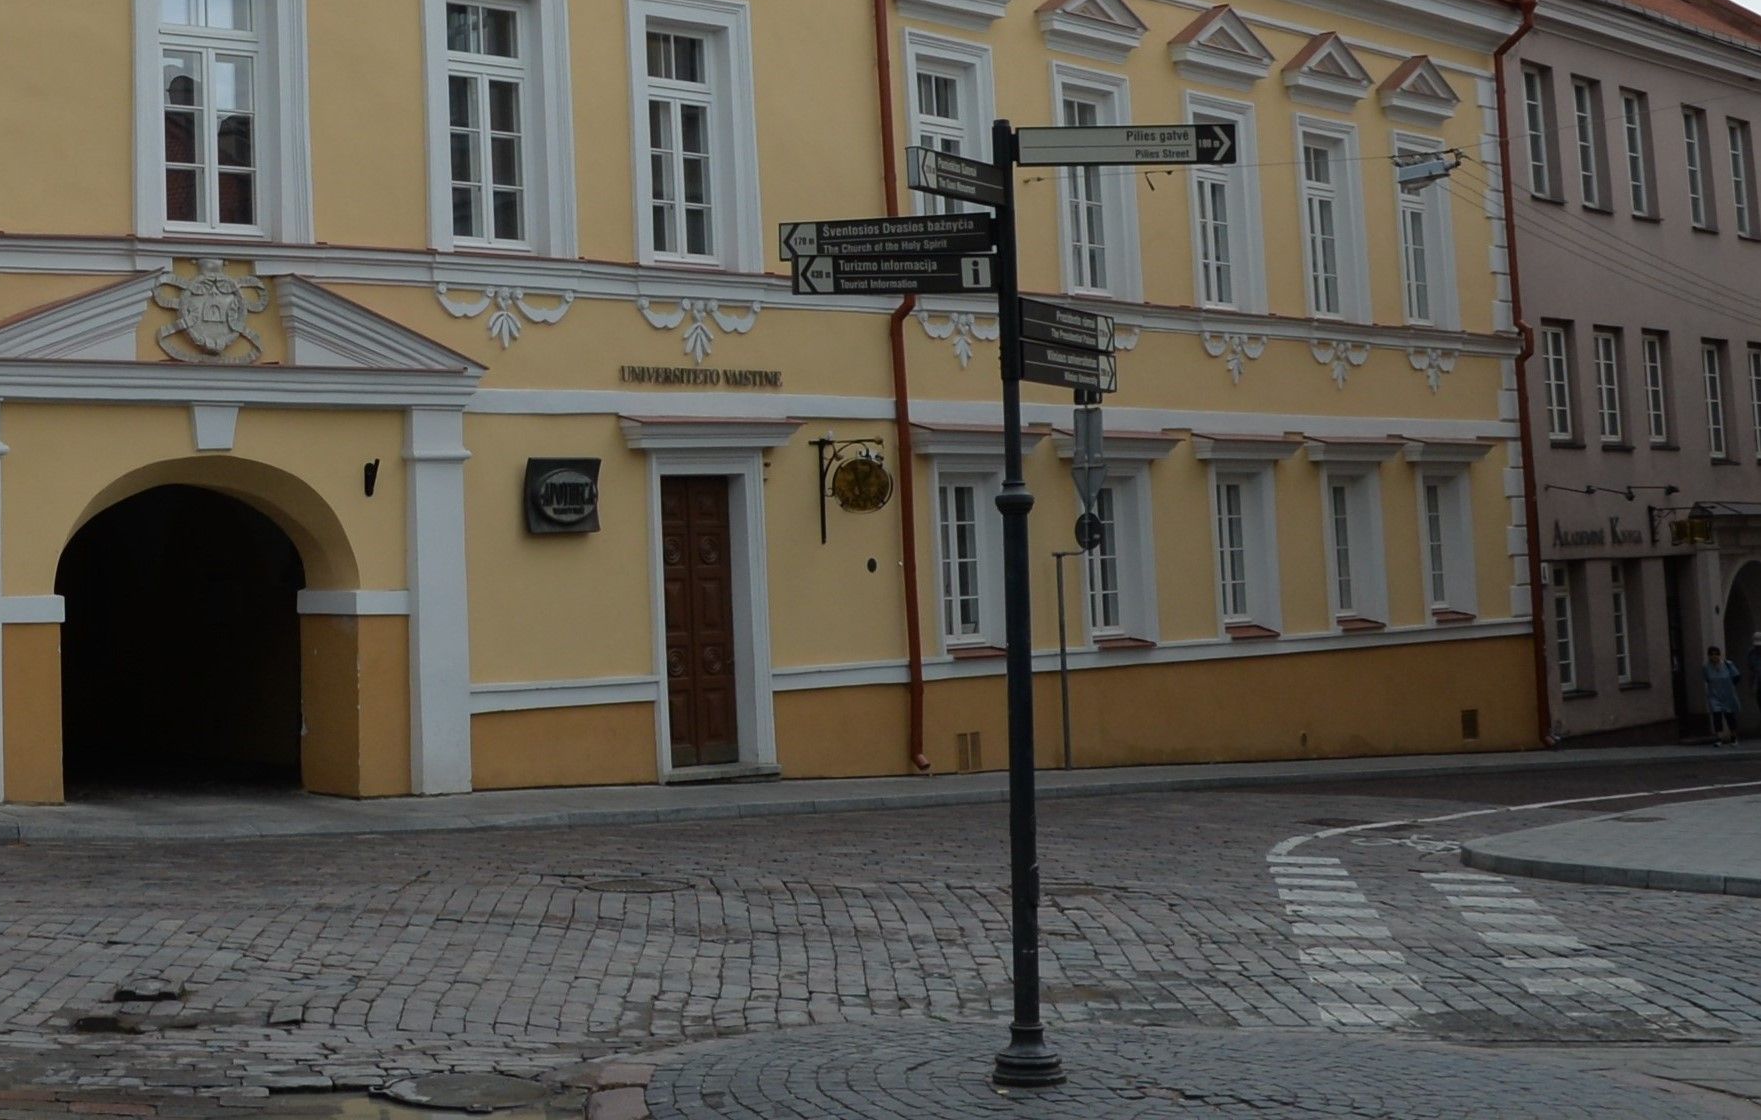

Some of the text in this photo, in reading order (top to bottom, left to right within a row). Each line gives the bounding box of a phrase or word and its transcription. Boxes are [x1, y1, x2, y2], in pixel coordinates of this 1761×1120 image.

[1126, 131, 1156, 141] Pilies
[1162, 149, 1189, 158] Street
[882, 221, 924, 234] Dvasios
[823, 244, 839, 254] The
[841, 243, 872, 253] Church
[885, 242, 899, 251] the
[901, 241, 921, 252] Holy
[923, 239, 947, 250] Spirit
[839, 259, 938, 271] Turizmo informacija
[840, 279, 917, 289] Tourist Information
[620, 365, 720, 385] UNIVERSITETO
